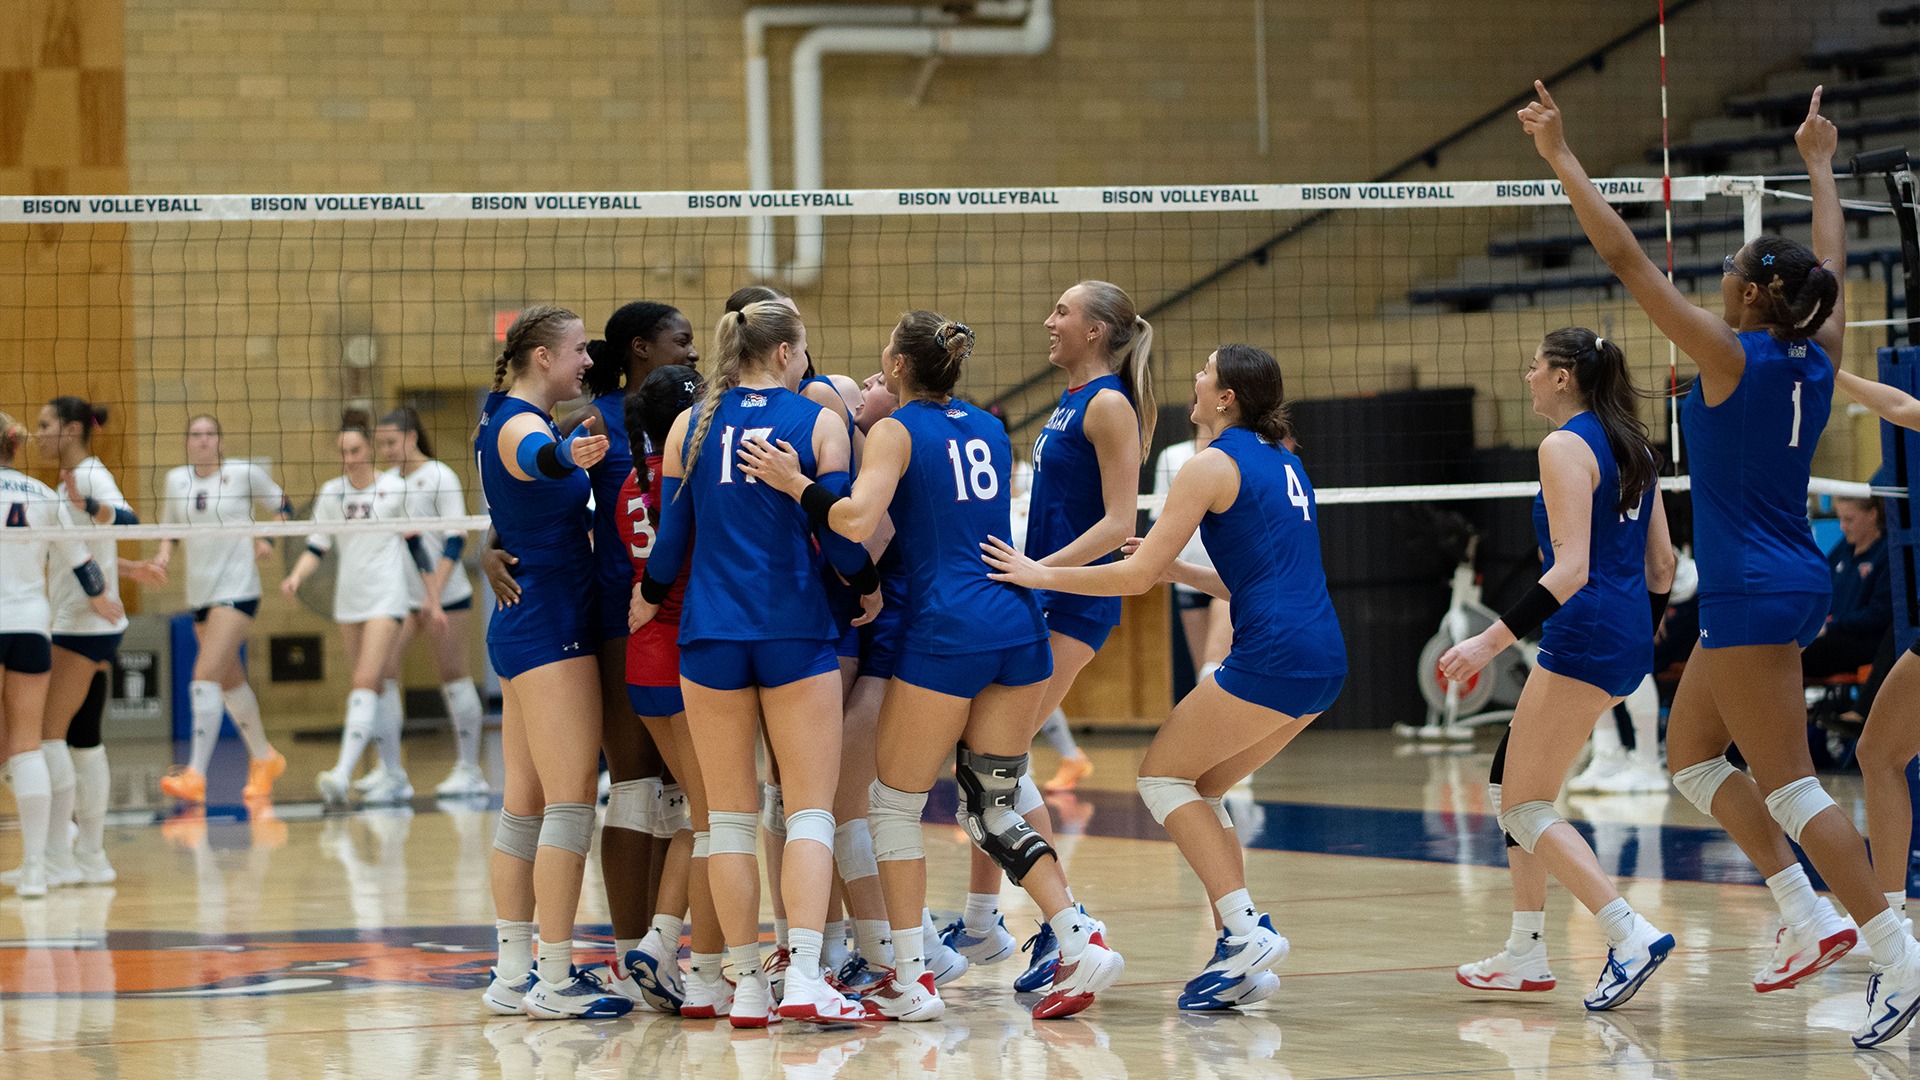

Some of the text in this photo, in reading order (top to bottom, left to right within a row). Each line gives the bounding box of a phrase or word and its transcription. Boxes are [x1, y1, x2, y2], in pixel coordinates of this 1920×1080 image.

[1102, 189, 1259, 203] BISON VOLLEYBALL
[1301, 186, 1455, 200] BISON VOLLEYBALL
[1496, 181, 1645, 197] BISON VYBALL
[22, 198, 203, 214] BISON VOLLEYBALL
[251, 196, 425, 211] BISON VOLLEYBALL
[471, 196, 642, 210] BISON VOLLEYBALL
[688, 193, 853, 208] BISON VOLLEYBALL
[898, 191, 1059, 206] BISON VOLLEYBALL
[1788, 381, 1802, 447] 1
[946, 438, 998, 501] 18
[1283, 463, 1311, 522] 4
[627, 495, 657, 559] 3
